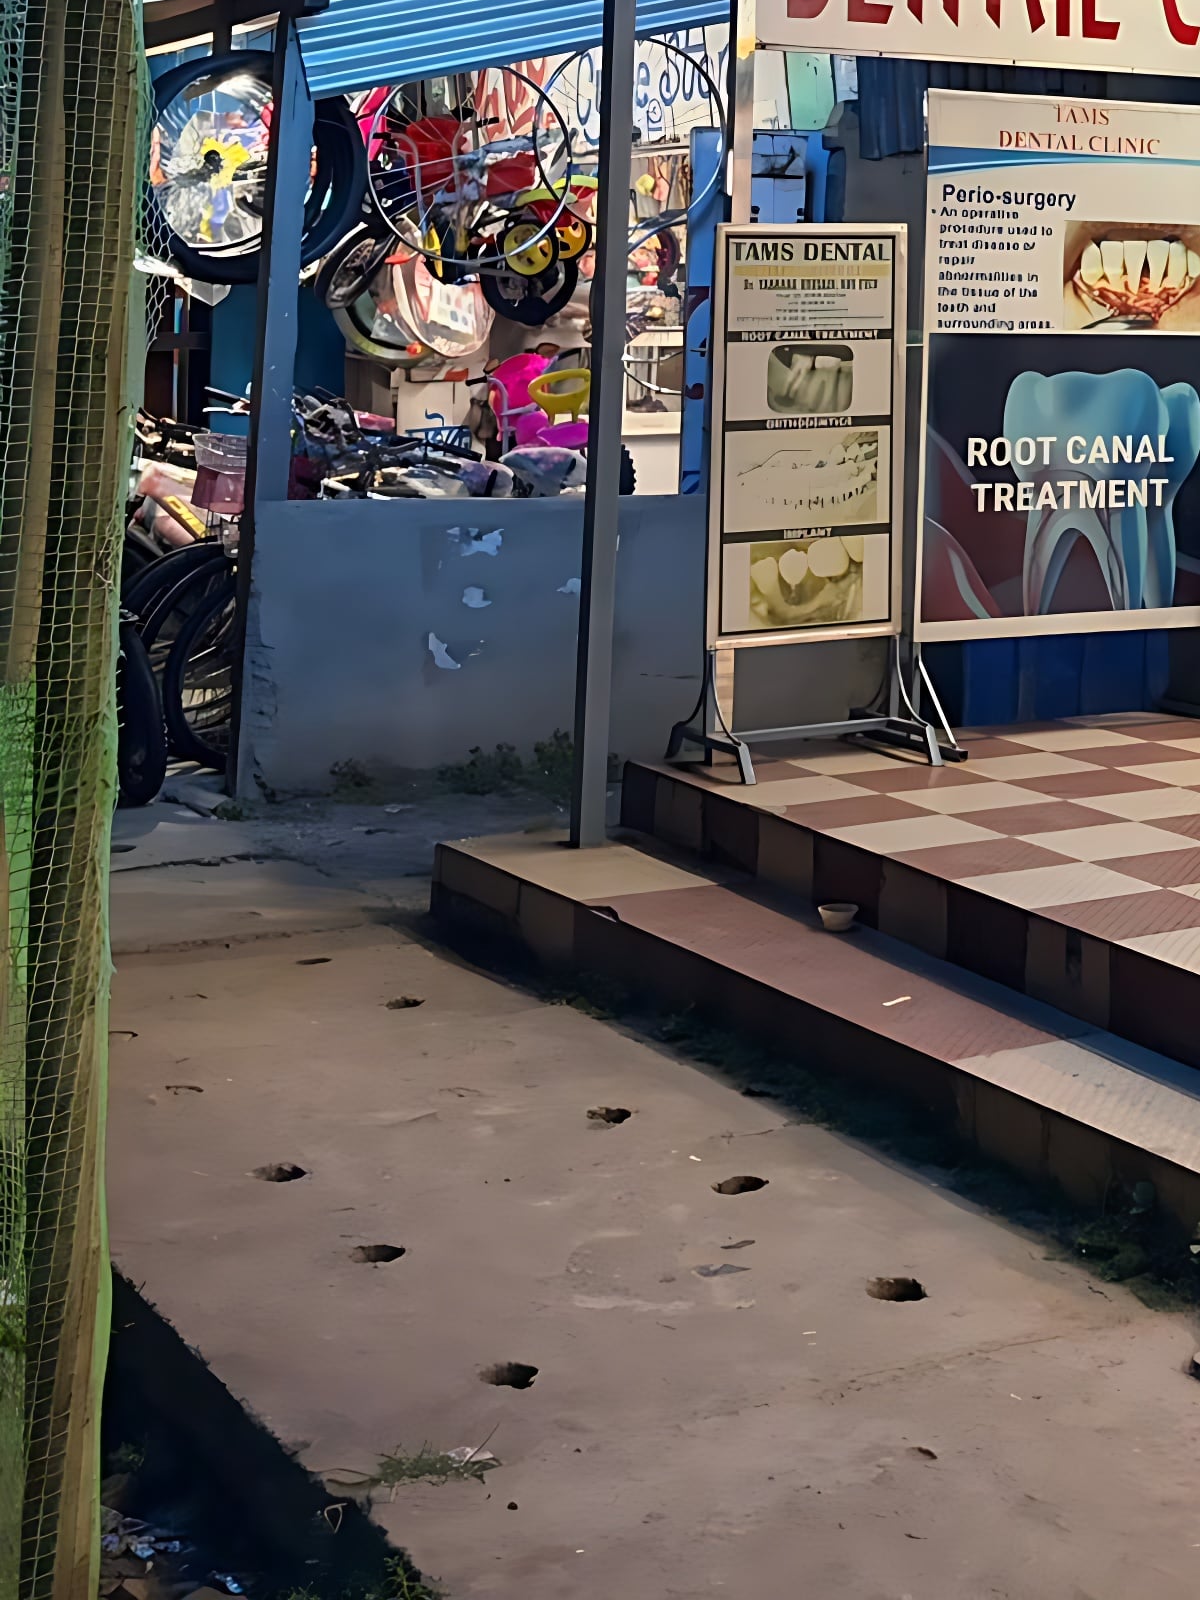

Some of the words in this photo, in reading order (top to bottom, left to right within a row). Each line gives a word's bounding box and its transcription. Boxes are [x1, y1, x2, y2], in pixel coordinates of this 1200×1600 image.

[1053, 104, 1110, 125] TAMS
[999, 130, 1083, 151] DENTAL
[1088, 135, 1160, 155] CLINIC
[942, 183, 1077, 211] Perio-surgery
[731, 242, 794, 262] TAMS
[803, 243, 891, 261] DENTAL
[967, 436, 1057, 467] ROOT
[1066, 434, 1174, 465] CANAL
[970, 478, 1169, 513] TREATMENT
